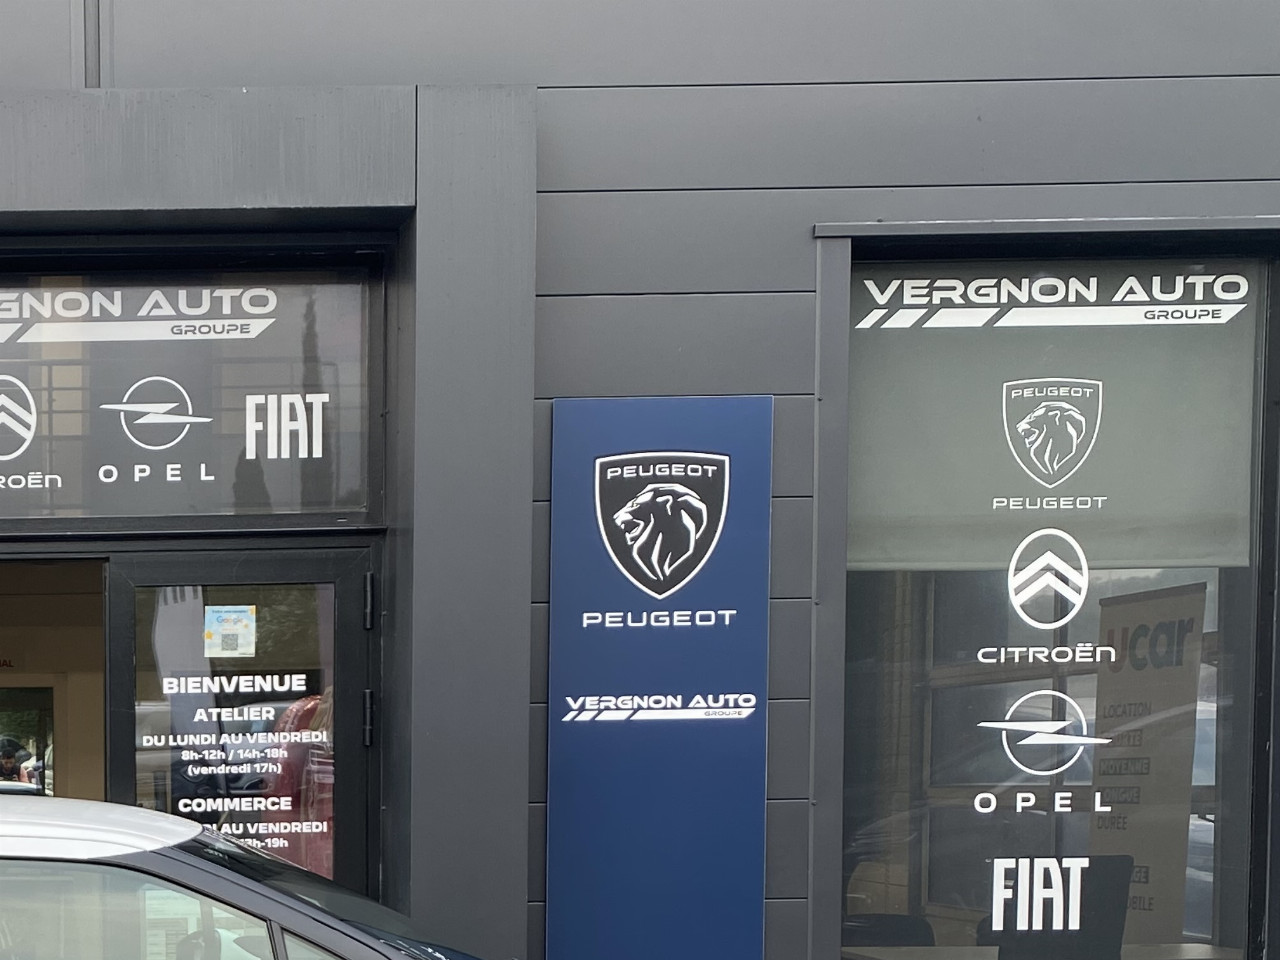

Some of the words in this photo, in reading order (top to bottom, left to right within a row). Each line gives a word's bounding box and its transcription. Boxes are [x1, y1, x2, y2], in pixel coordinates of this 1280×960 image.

[864, 278, 1097, 304] VERGNON
[1112, 275, 1248, 301] AUTO
[137, 289, 277, 316] AUTO
[1144, 309, 1221, 319] GROUPE
[170, 323, 251, 336] GROUPE
[1011, 386, 1094, 398] PEUGEOT
[246, 394, 329, 459] FIAT
[99, 464, 214, 482] OPEL
[607, 464, 717, 479] PEUGEOT
[993, 497, 1107, 509] PEUGEOT
[583, 610, 736, 627] PEUGEOT
[1106, 617, 1195, 674] ucar
[162, 674, 307, 694] BIENVENUE
[565, 694, 683, 710] VERGNON
[688, 694, 756, 707] AUTO
[193, 707, 276, 721] ATELIER
[1103, 702, 1152, 719] LOCATION
[142, 735, 166, 747] DU
[169, 734, 216, 746] LUNDI
[219, 733, 243, 745] AU
[246, 731, 327, 744] VENDREDI
[181, 750, 226, 761] 8h-12h
[238, 748, 288, 760] 14h-18h
[188, 764, 251, 776] (vendredi
[254, 763, 281, 773] 17h)
[179, 797, 292, 812] COMMERCE
[974, 792, 1111, 813] OPEL
[219, 823, 244, 834] AU
[247, 822, 327, 833] VENDREDI
[992, 857, 1090, 931] FIAT
